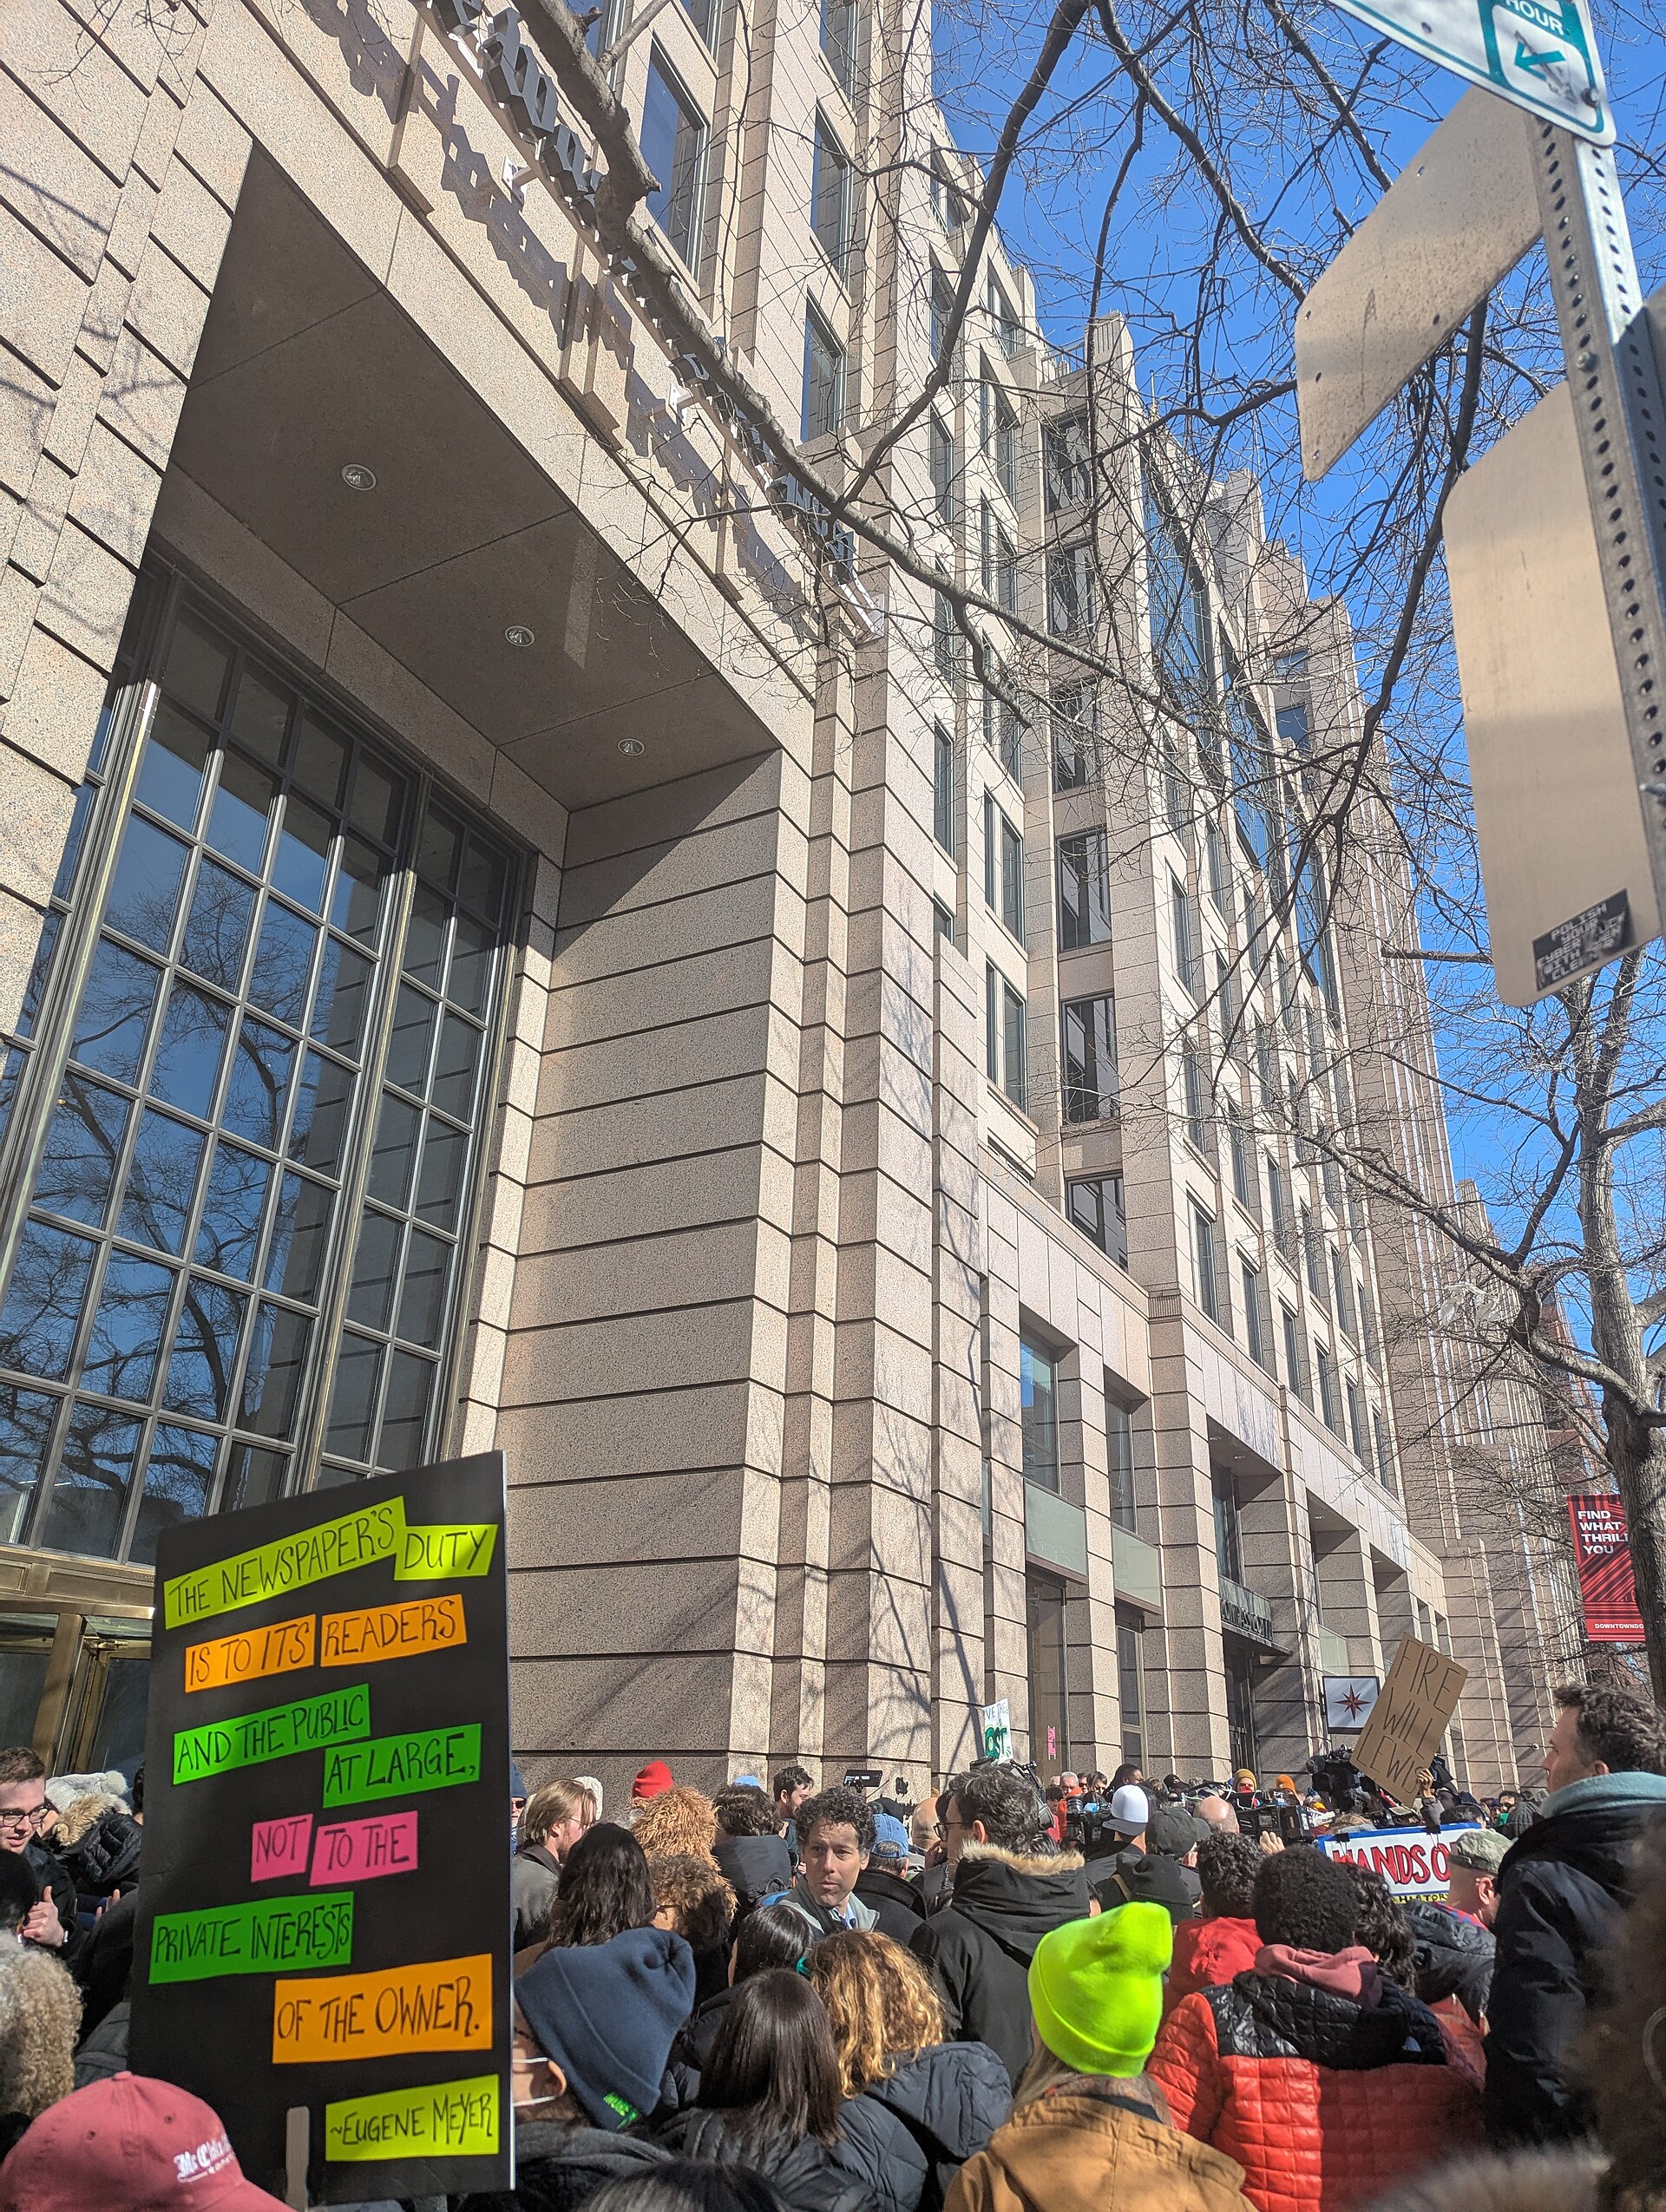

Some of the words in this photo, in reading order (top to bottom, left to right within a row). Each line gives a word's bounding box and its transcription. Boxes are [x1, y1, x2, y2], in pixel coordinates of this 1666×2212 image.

[1506, 0, 1564, 36] HOUR
[1551, 903, 1607, 941] POLISH
[1577, 1510, 1611, 1520] FIND
[1579, 1522, 1622, 1531] WHAT
[168, 1576, 211, 1618] THE
[221, 1508, 394, 1604] NEWSPAPER'S
[403, 1529, 486, 1571] DUTY
[1583, 1545, 1614, 1554] YOU
[189, 1646, 211, 1685] IS
[220, 1639, 251, 1679] TO
[261, 1621, 311, 1671] ITS
[324, 1600, 456, 1657] READERS
[1394, 1639, 1461, 1716] FIRE
[177, 1730, 231, 1773] AND
[235, 1714, 285, 1759] THE
[292, 1694, 364, 1744] PUBLIC
[1382, 1686, 1434, 1760] WILL
[325, 1753, 362, 1794] AT
[366, 1732, 476, 1784] LARGE,
[1356, 1724, 1425, 1794] LEWIS
[255, 1819, 307, 1864] NOT
[324, 1829, 352, 1870] TO
[363, 1823, 410, 1868] THE
[154, 1918, 242, 1963] PRIVATE
[251, 1902, 351, 1960] INTERESTS
[278, 1999, 312, 2041] OF
[319, 1993, 364, 2043] THE
[375, 1975, 480, 2038] OWNER.
[433, 2091, 493, 2145] MEYER
